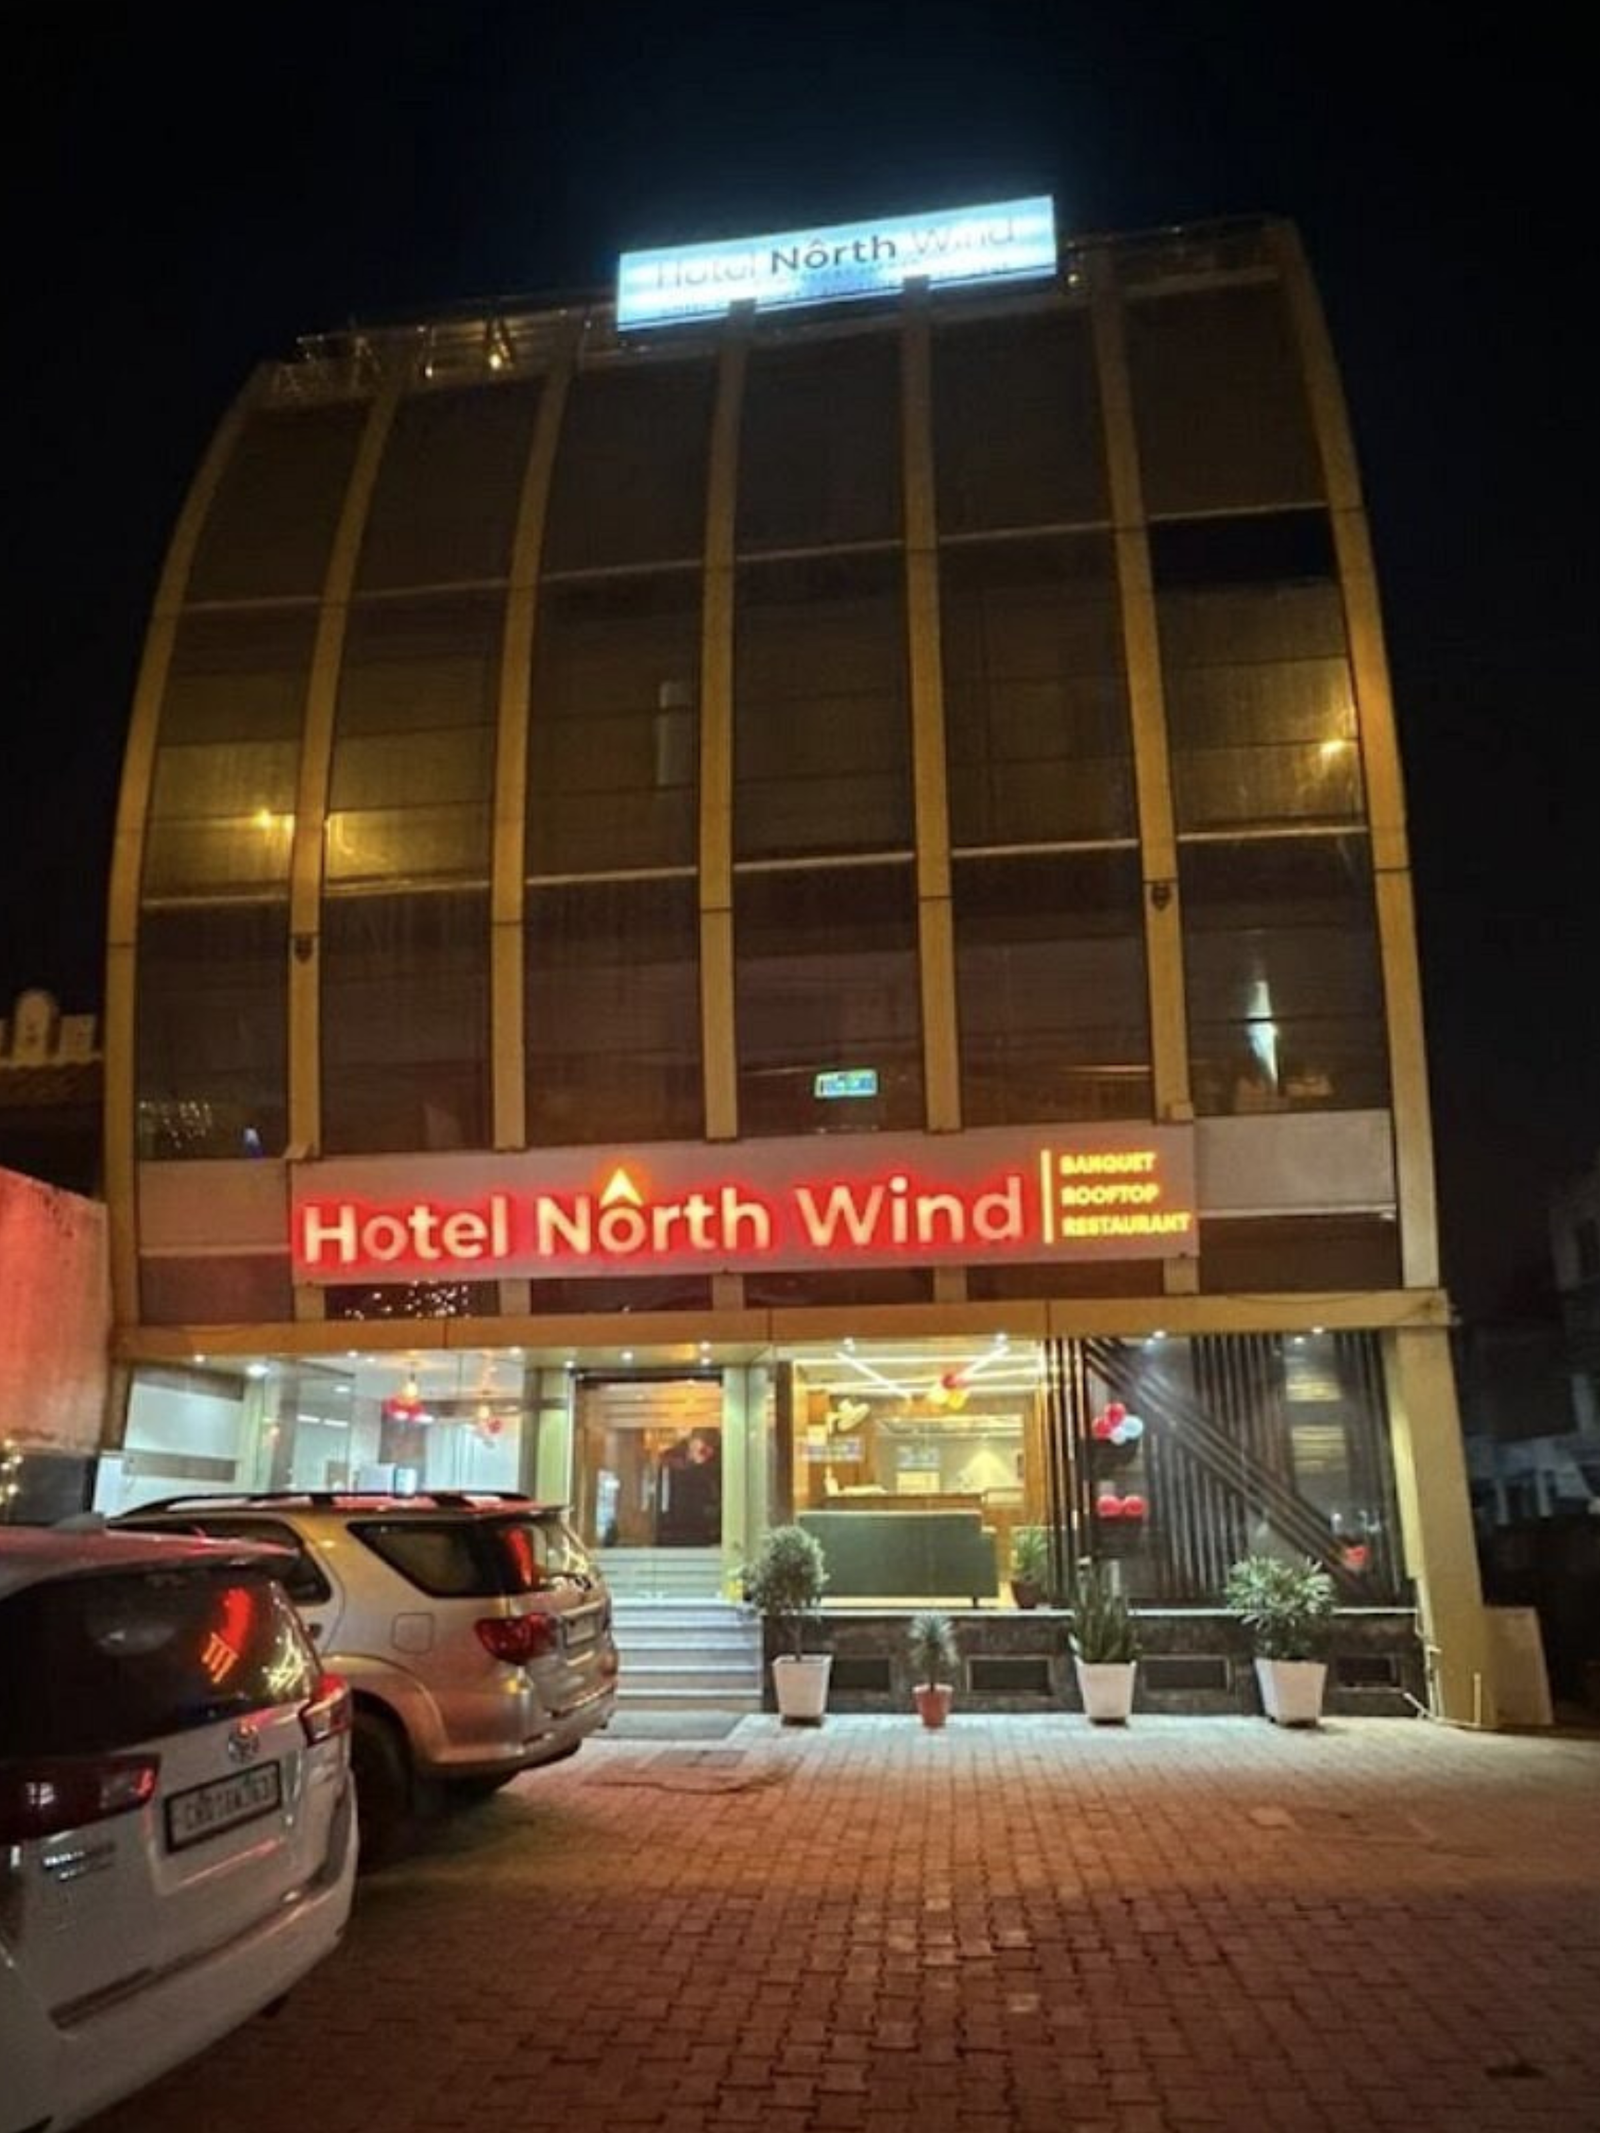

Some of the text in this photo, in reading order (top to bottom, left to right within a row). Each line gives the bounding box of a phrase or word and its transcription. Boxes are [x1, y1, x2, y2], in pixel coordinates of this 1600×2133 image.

[1060, 1151, 1157, 1175] BANQUET
[1061, 1182, 1160, 1206] ROOFTOP
[303, 1195, 509, 1264] Hotel
[795, 1176, 1024, 1247] Wind
[1062, 1211, 1191, 1237] RESTAURANT
